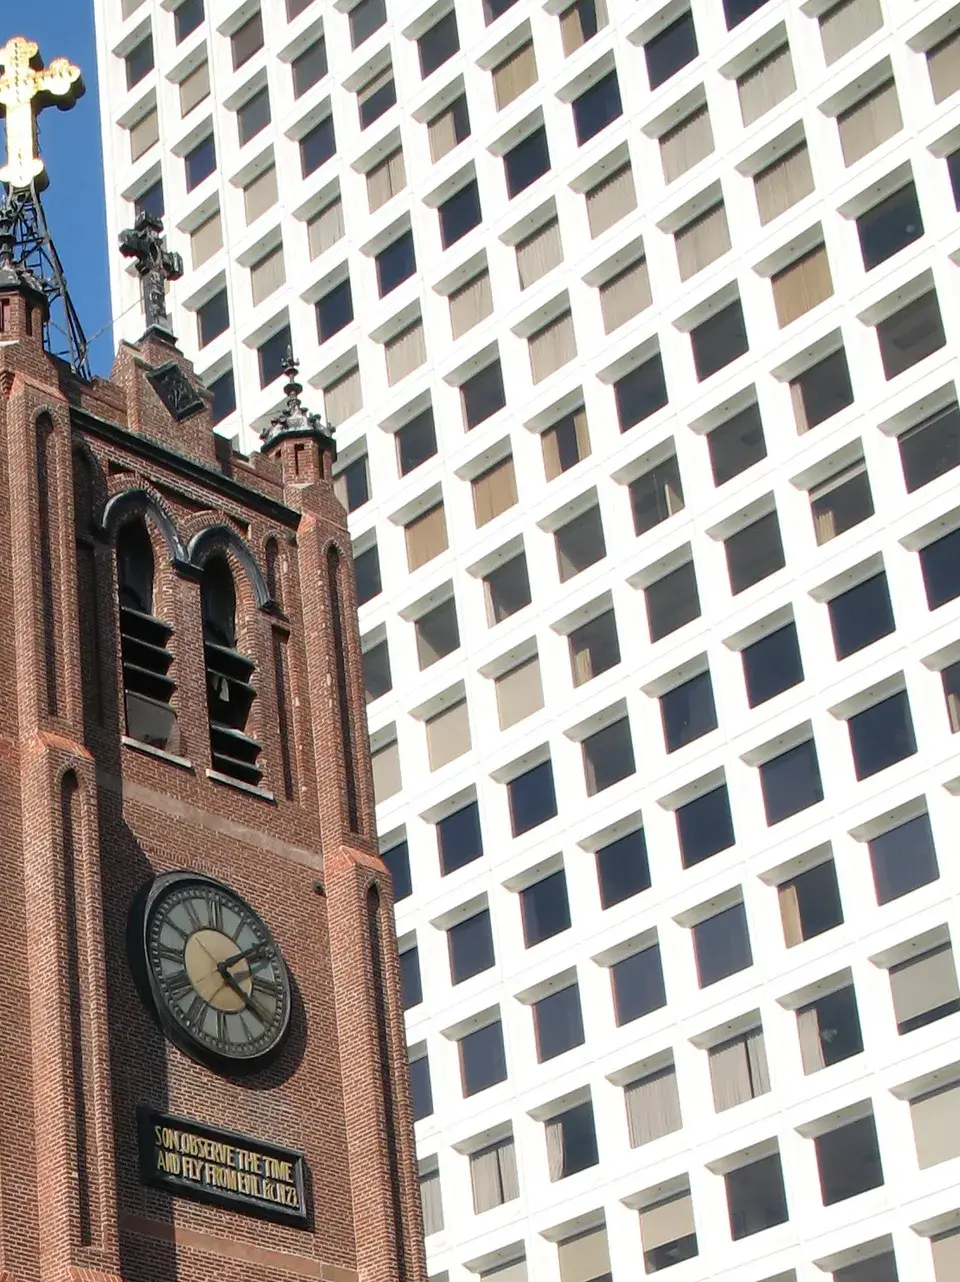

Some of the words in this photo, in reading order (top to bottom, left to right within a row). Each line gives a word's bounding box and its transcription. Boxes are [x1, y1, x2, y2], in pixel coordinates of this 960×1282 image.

[157, 1150, 180, 1175] AND
[182, 1156, 204, 1181] FLY
[205, 1162, 237, 1191] FROM
[181, 1132, 235, 1167] OBSERVE
[237, 1150, 262, 1174] THE
[263, 1156, 293, 1183] TIME
